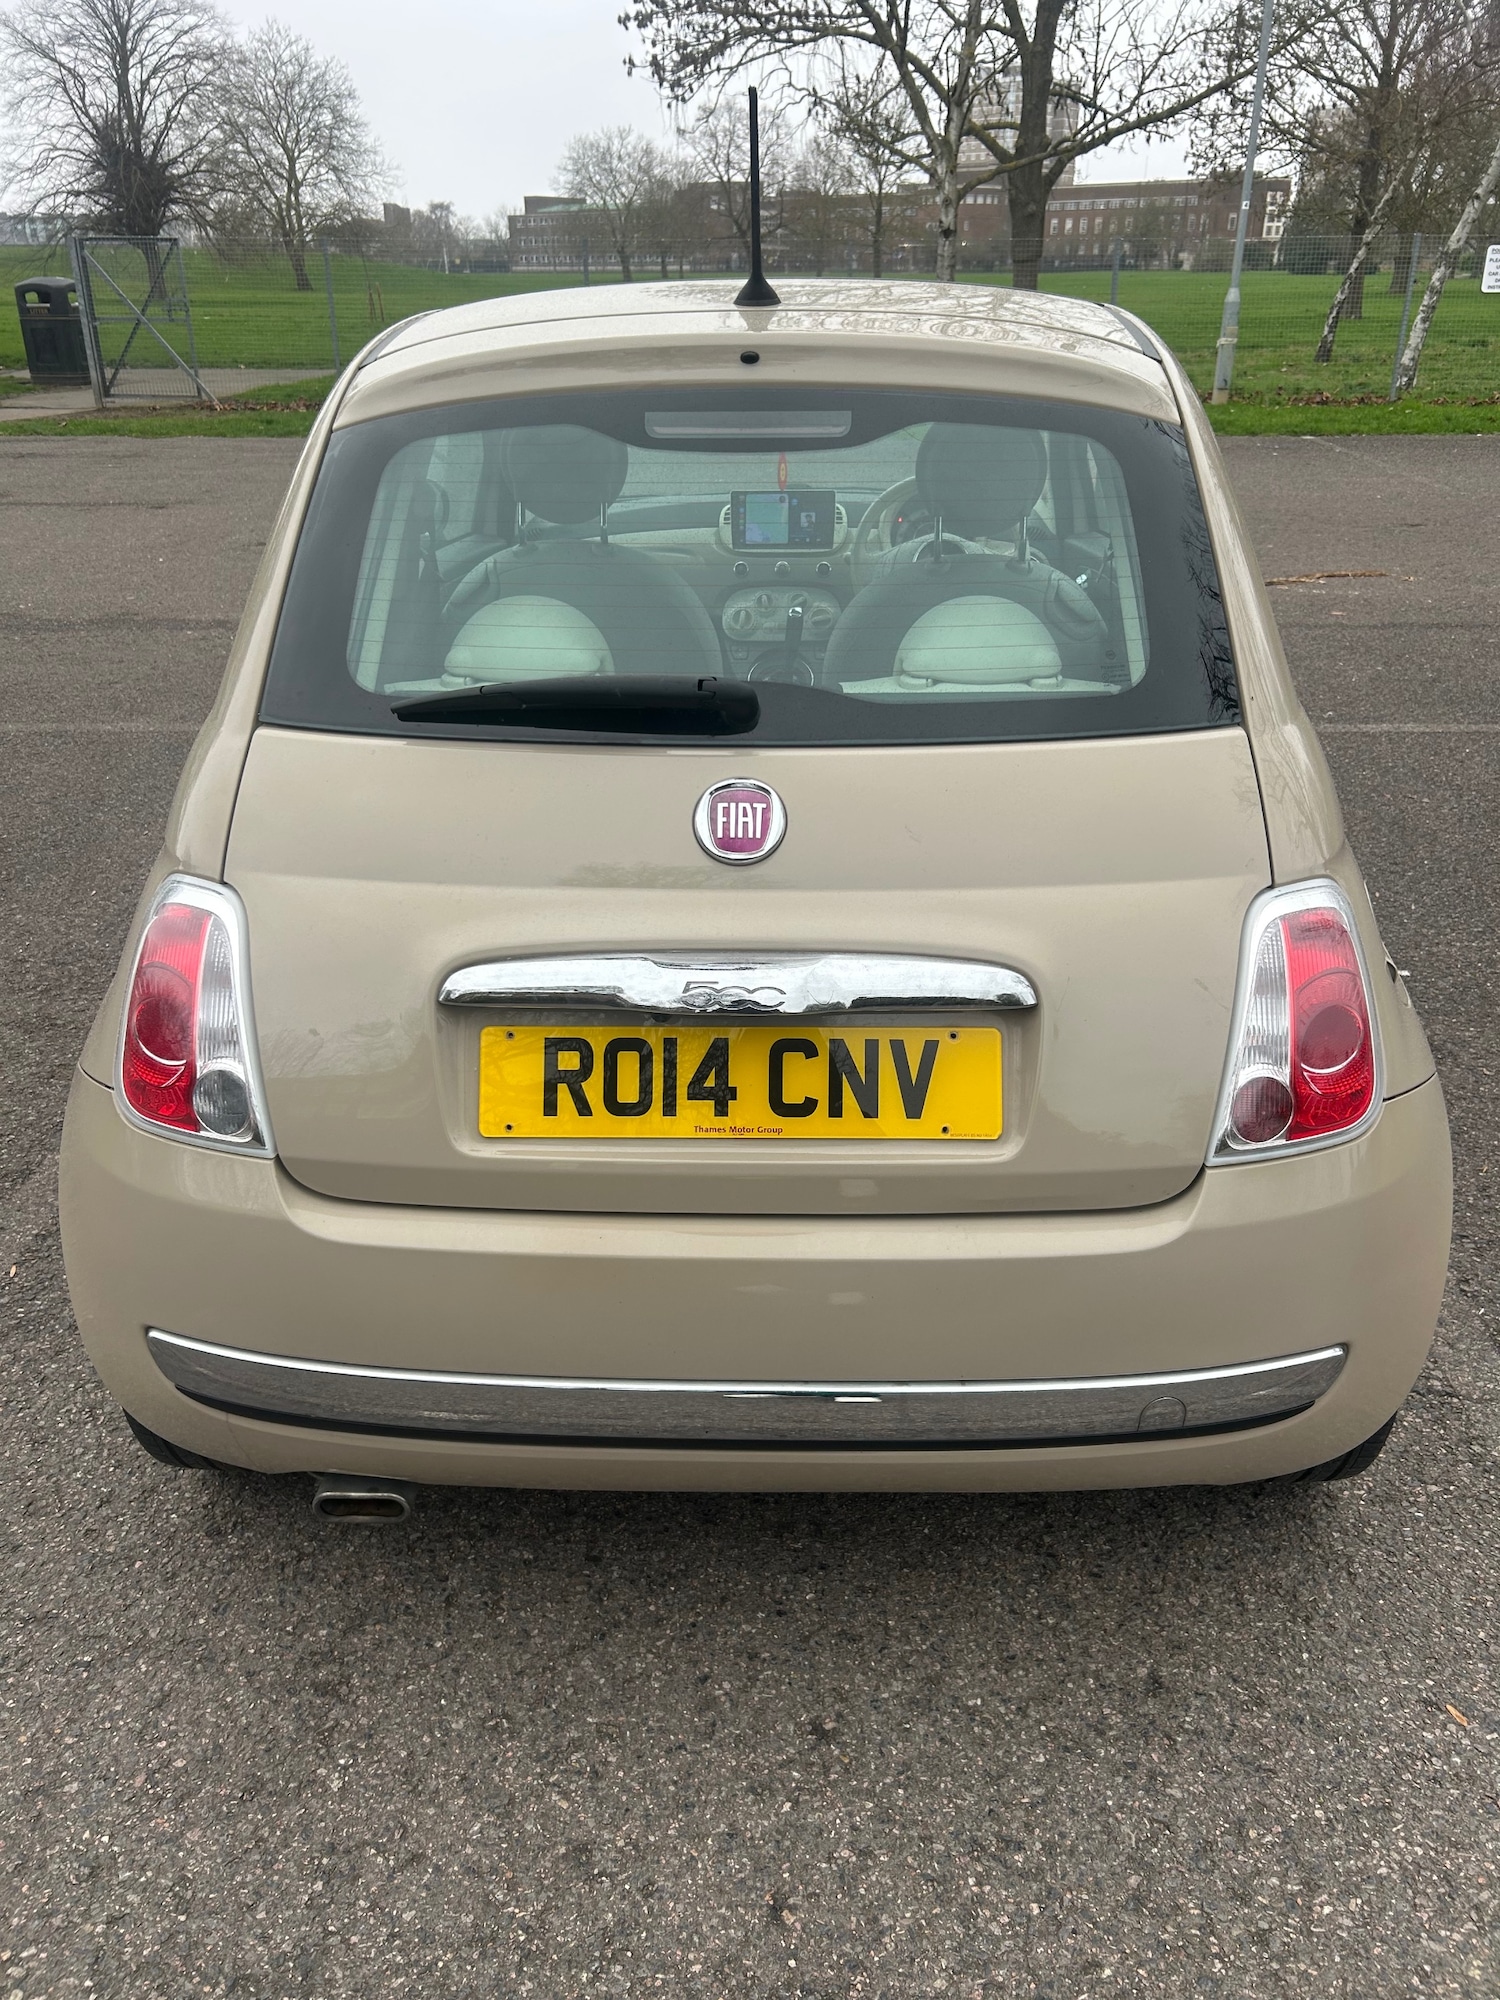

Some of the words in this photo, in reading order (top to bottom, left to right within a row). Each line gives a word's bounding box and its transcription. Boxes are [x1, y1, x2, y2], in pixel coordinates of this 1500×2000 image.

[717, 802, 767, 839] FIAT
[682, 981, 787, 1010] 500
[543, 1037, 738, 1117] RO14
[768, 1038, 940, 1119] CNV
[694, 1125, 727, 1134] Thames
[729, 1125, 755, 1134] Motor
[757, 1126, 783, 1136] Group
